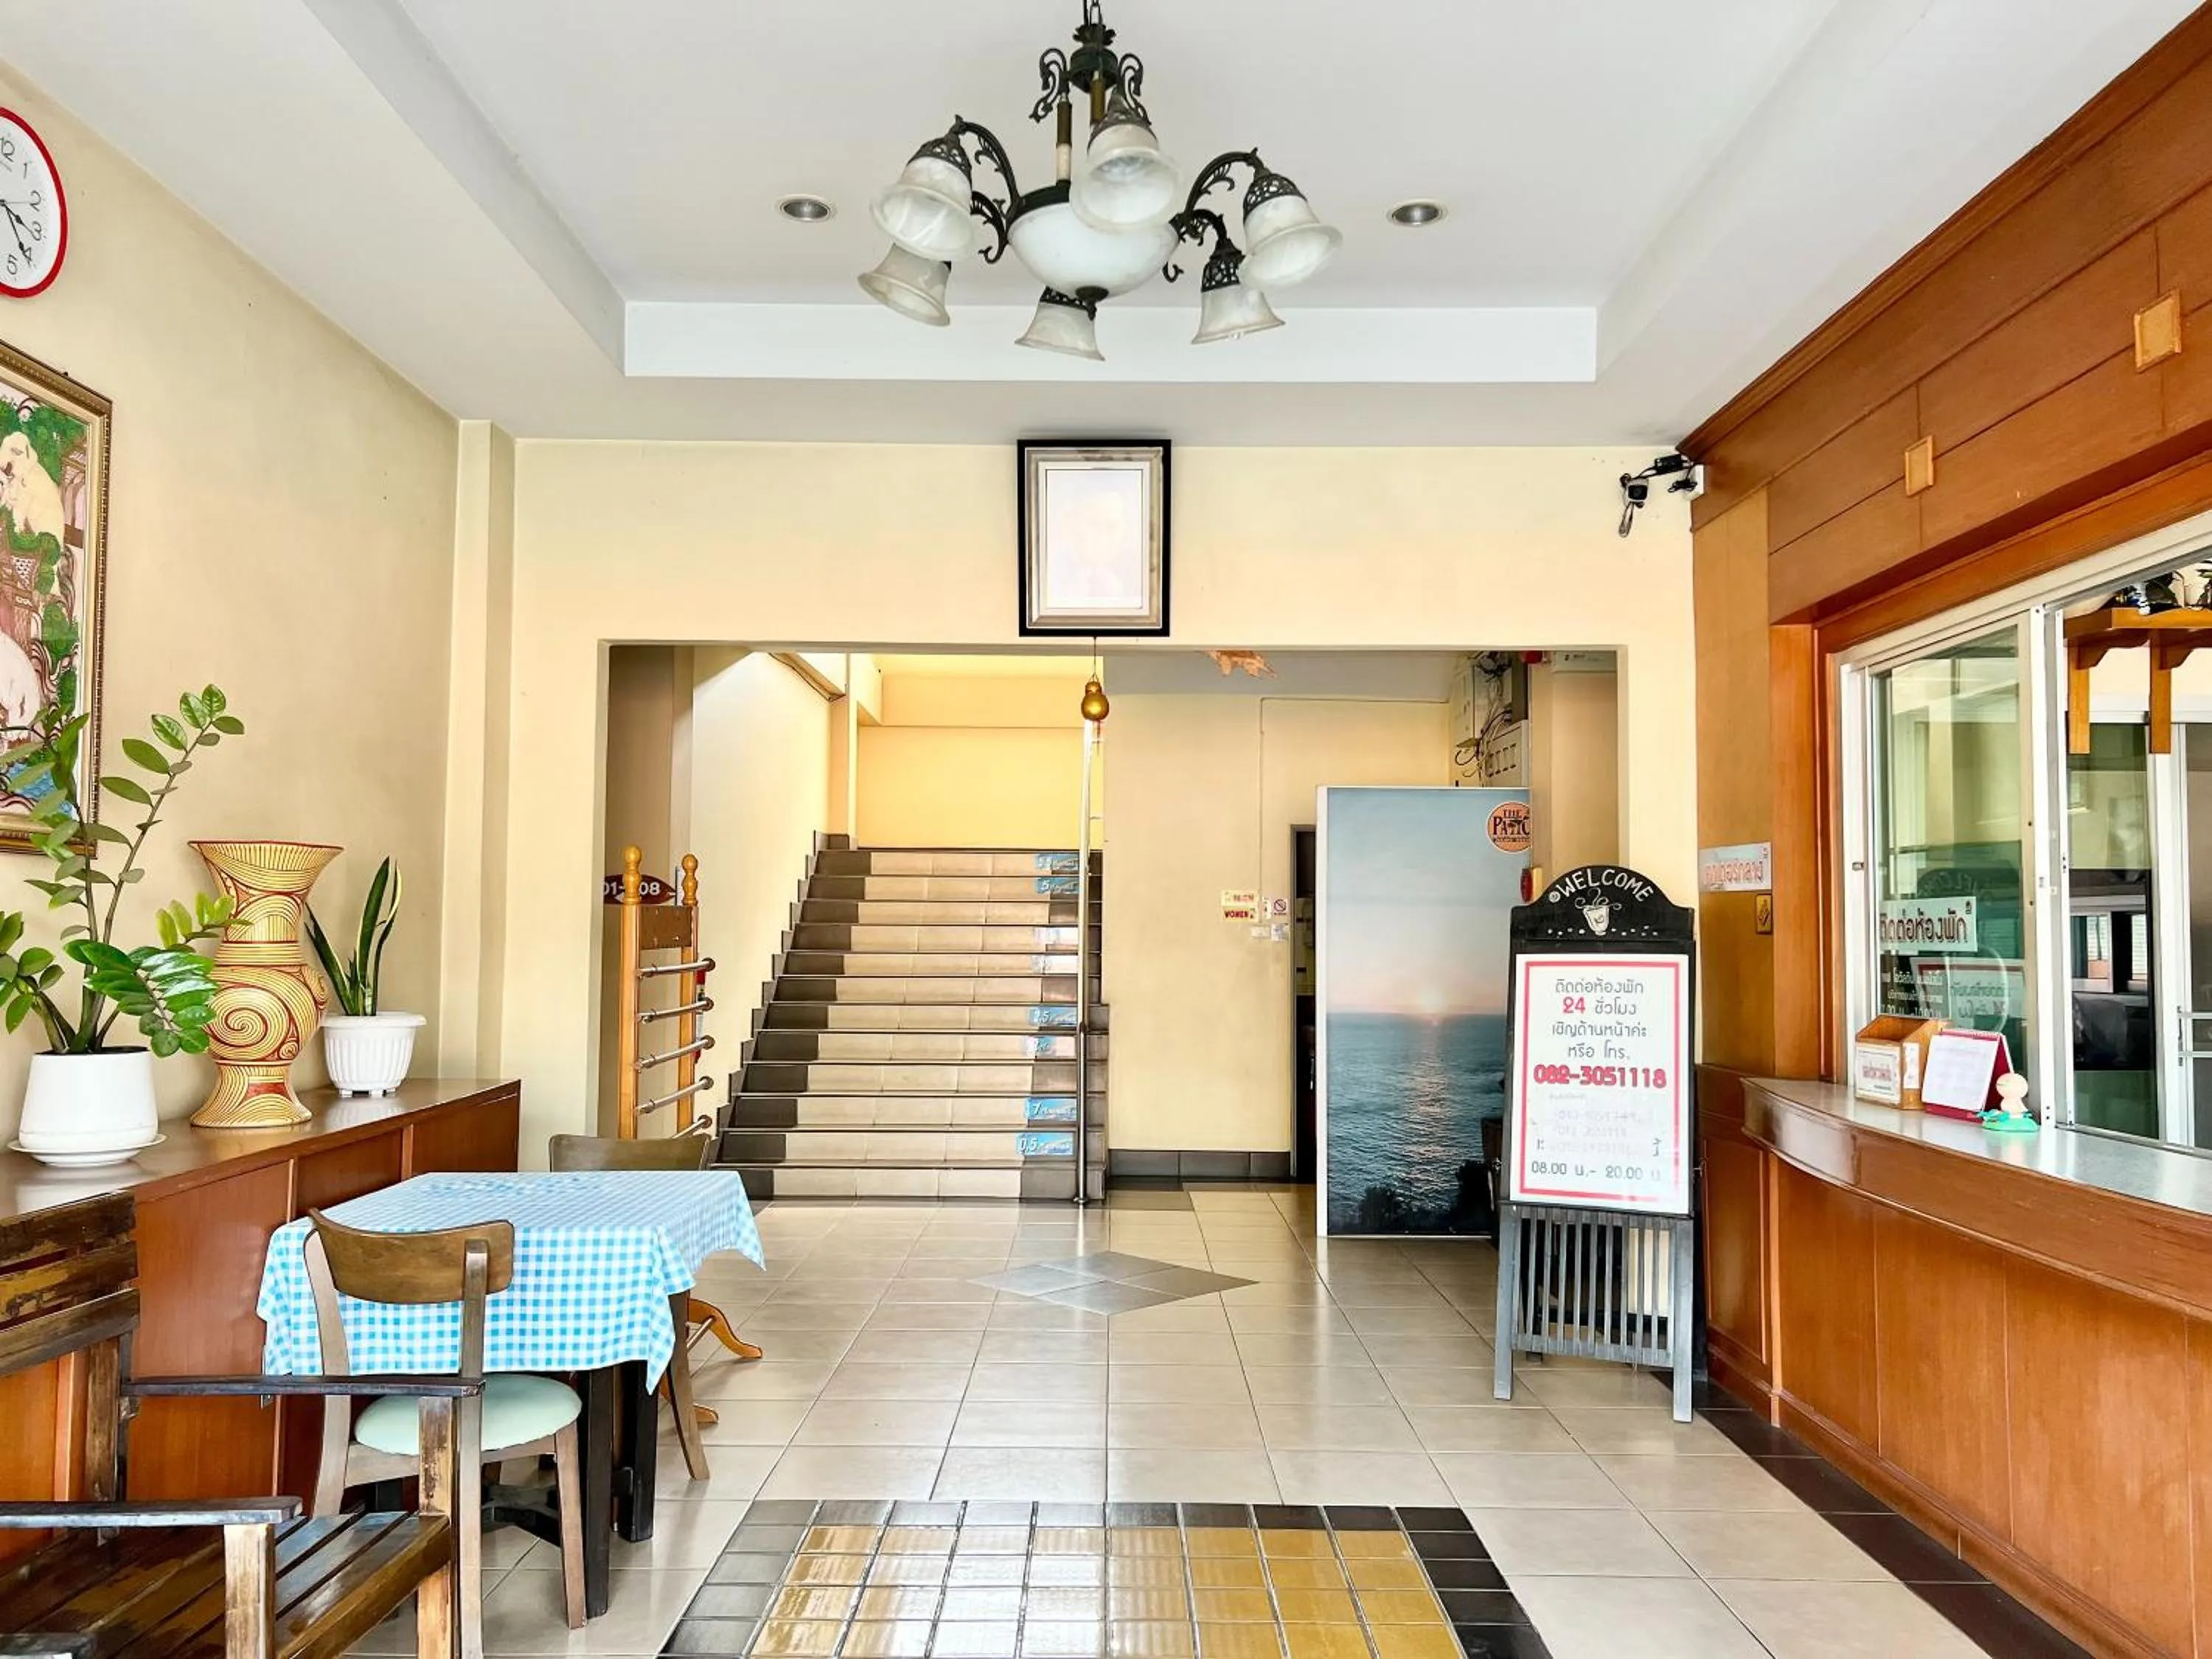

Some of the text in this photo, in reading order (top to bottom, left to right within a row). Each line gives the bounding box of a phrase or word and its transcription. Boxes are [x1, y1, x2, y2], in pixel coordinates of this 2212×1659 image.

[29, 190, 41, 212] 2
[32, 220, 42, 241] 3
[7, 254, 18, 275] 5
[1556, 869, 1654, 902] WELCOME
[1555, 978, 1644, 994] ติดต่อห้องพัก
[1562, 996, 1637, 1015] 24 ชั่วโมง
[1568, 1040, 1631, 1060] หรือ โทร.
[1533, 1064, 1667, 1088] 082-3051118
[1531, 1161, 1568, 1175] 08.00
[1605, 1165, 1644, 1180] 20.00
